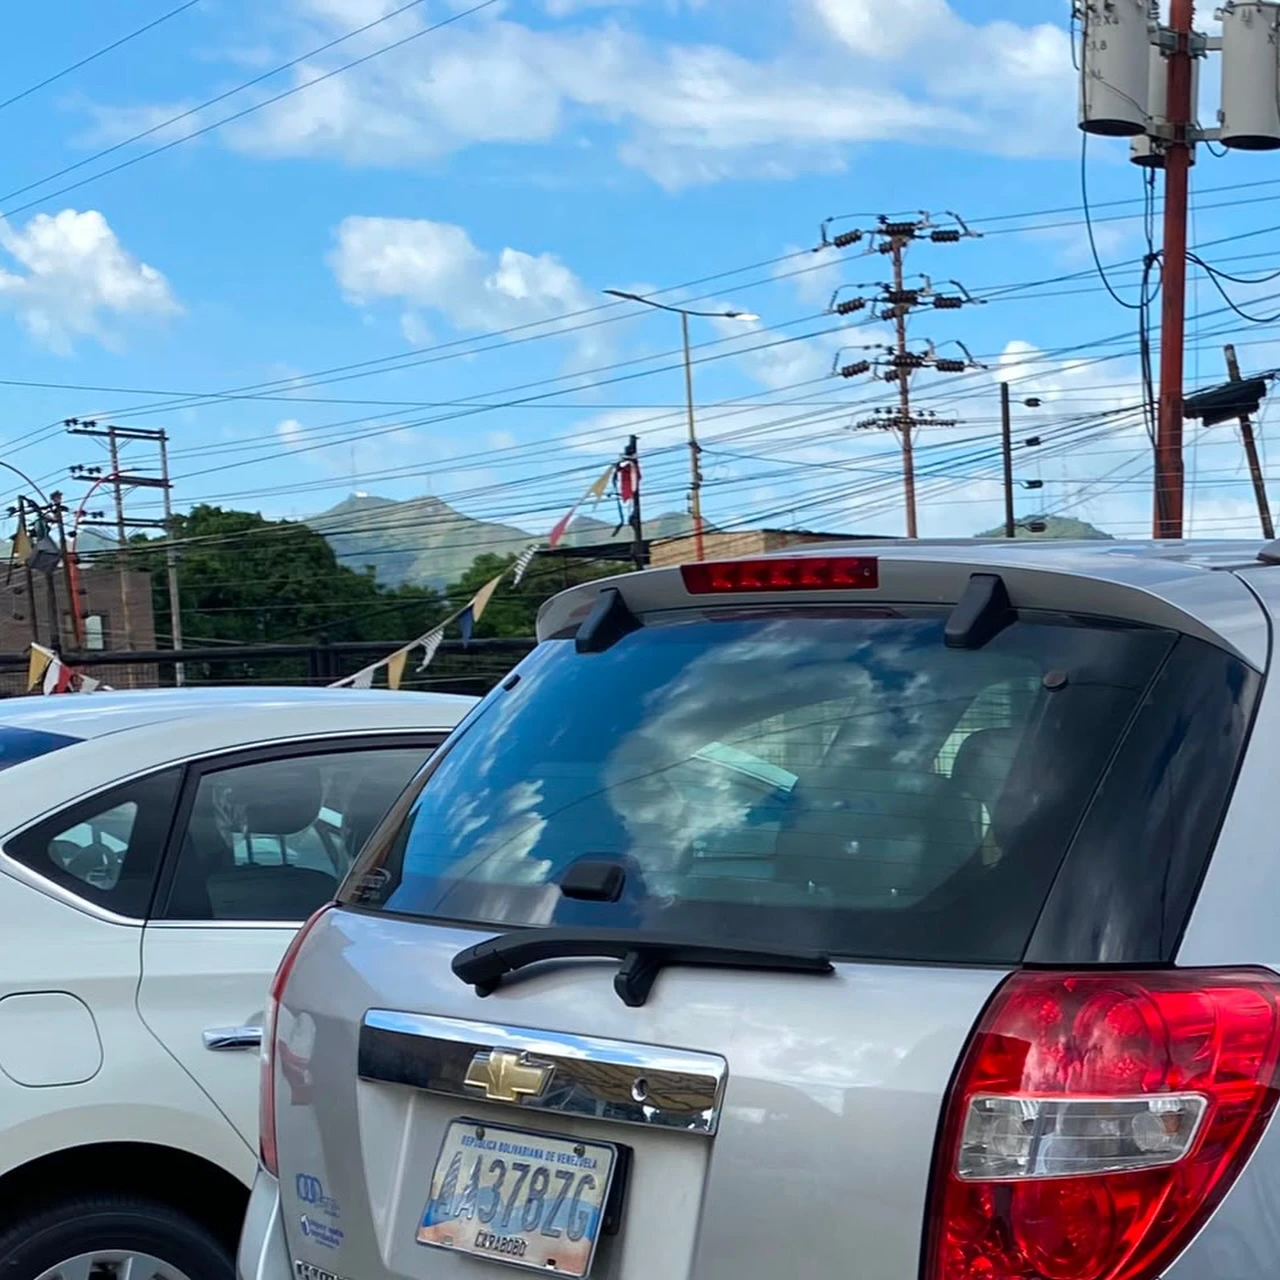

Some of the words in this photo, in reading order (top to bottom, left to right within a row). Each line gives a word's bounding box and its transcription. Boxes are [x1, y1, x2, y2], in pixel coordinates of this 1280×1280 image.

[545, 1151, 555, 1162] DE
[434, 1151, 596, 1241] AA378ZG
[474, 1230, 527, 1256] CARABOBO
